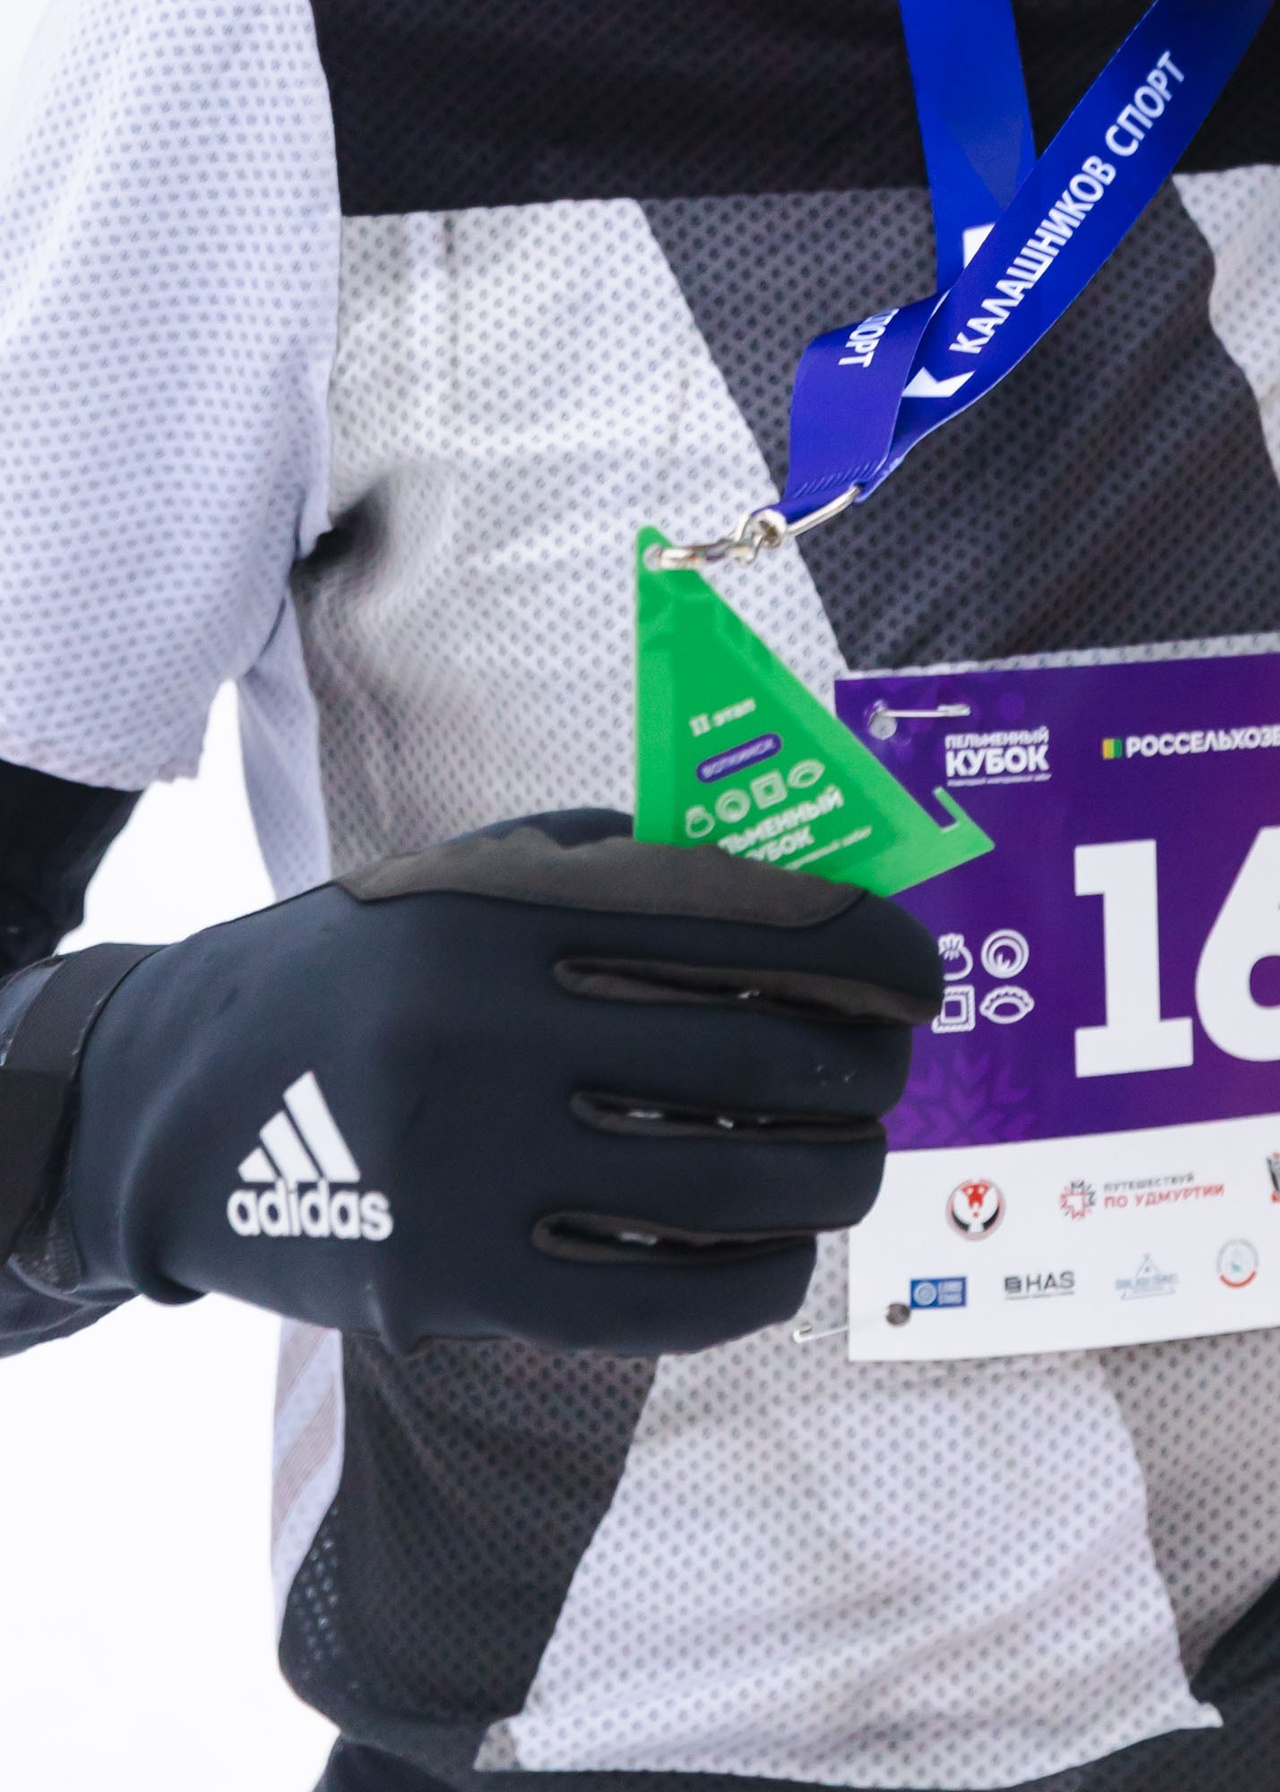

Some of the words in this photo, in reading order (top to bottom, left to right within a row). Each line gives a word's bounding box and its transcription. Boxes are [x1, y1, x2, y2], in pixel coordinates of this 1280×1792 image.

[949, 155, 1117, 354] КАЛАШНИКОВ
[1105, 50, 1186, 157] СПОРТ
[945, 745, 1050, 777] КУБОК
[226, 1177, 394, 1242] adidas
[1103, 1193, 1130, 1209] ПО
[1134, 1183, 1226, 1207] УДМУРТИИ
